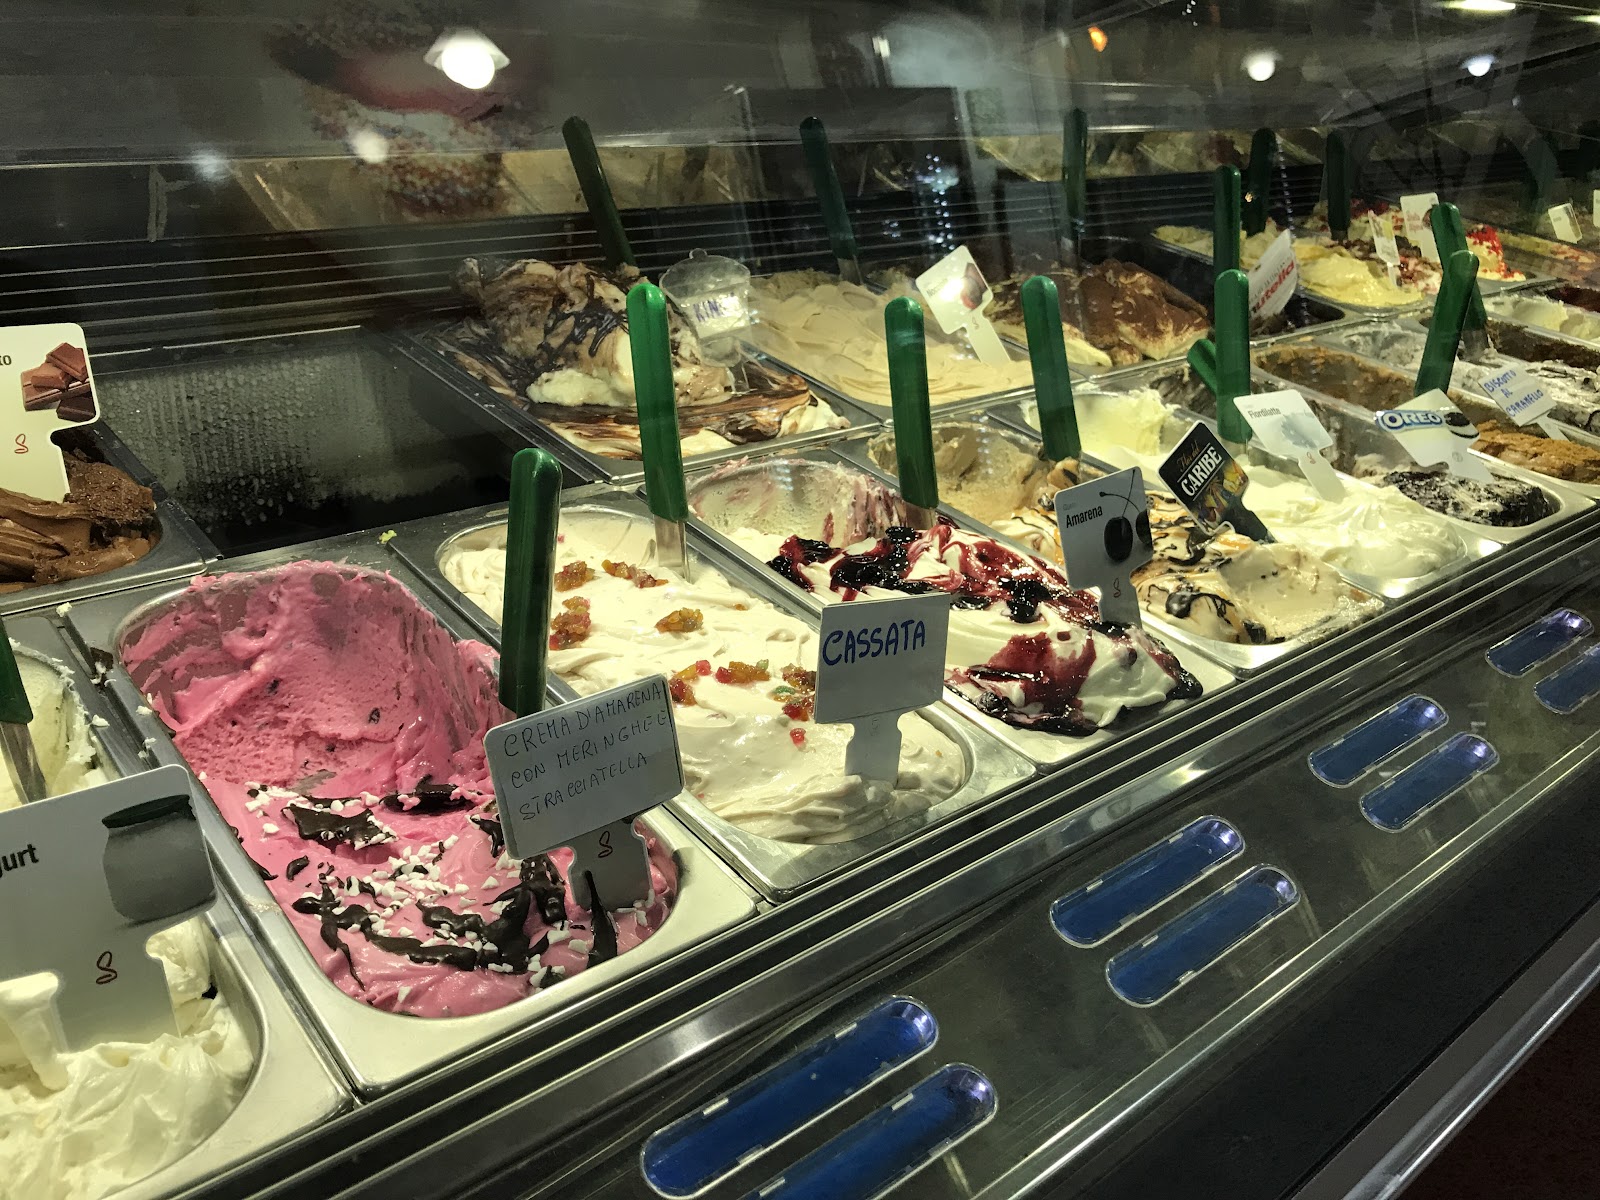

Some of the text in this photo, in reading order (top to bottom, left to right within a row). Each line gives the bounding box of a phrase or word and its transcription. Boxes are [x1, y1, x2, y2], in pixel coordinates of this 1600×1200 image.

[1484, 369, 1517, 393] BISCOTTO
[1505, 389, 1544, 417] CARAMELLO
[1381, 411, 1443, 430] OREO
[1181, 446, 1222, 496] CARIBE
[1066, 505, 1103, 528] Amarena
[822, 619, 926, 666] CASSATA
[504, 682, 662, 757] CREMA D'AMARENA
[511, 762, 546, 789] CON
[0, 844, 39, 878] urt
